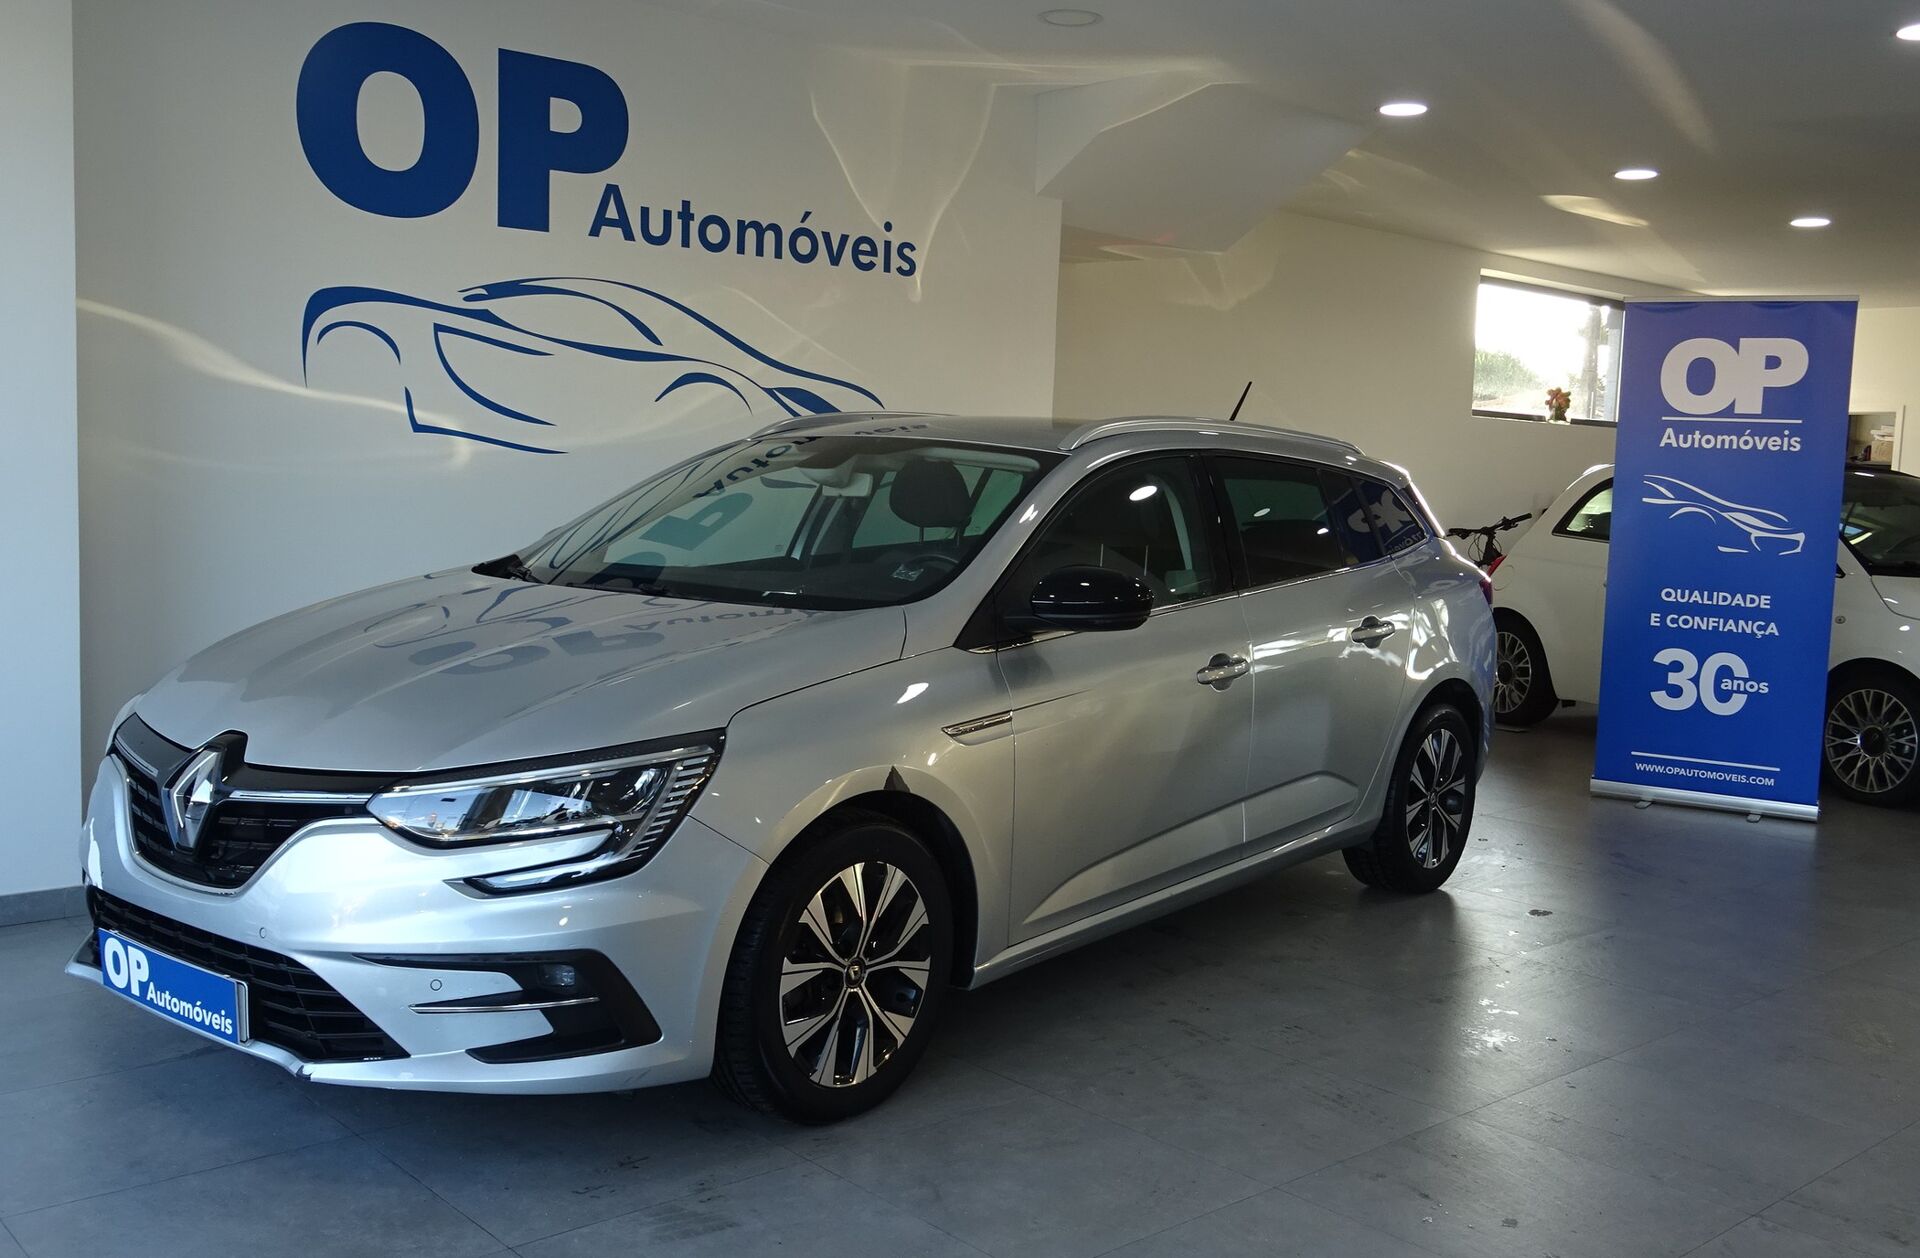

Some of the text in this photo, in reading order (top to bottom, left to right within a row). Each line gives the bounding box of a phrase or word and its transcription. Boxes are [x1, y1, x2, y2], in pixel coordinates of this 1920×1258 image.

[296, 21, 629, 233] OP
[588, 183, 918, 277] Automóveis
[1660, 337, 1809, 415] OP
[1659, 427, 1802, 452] Automóveis
[1650, 612, 1780, 639] E CONFIANÇA
[1660, 588, 1771, 609] QUALIDADE
[1650, 647, 1770, 716] 30 anos
[1635, 762, 1776, 787] WWW.OPAUTOMOVEIS.COM
[104, 937, 150, 997] OP
[146, 981, 233, 1035] Automóveis
